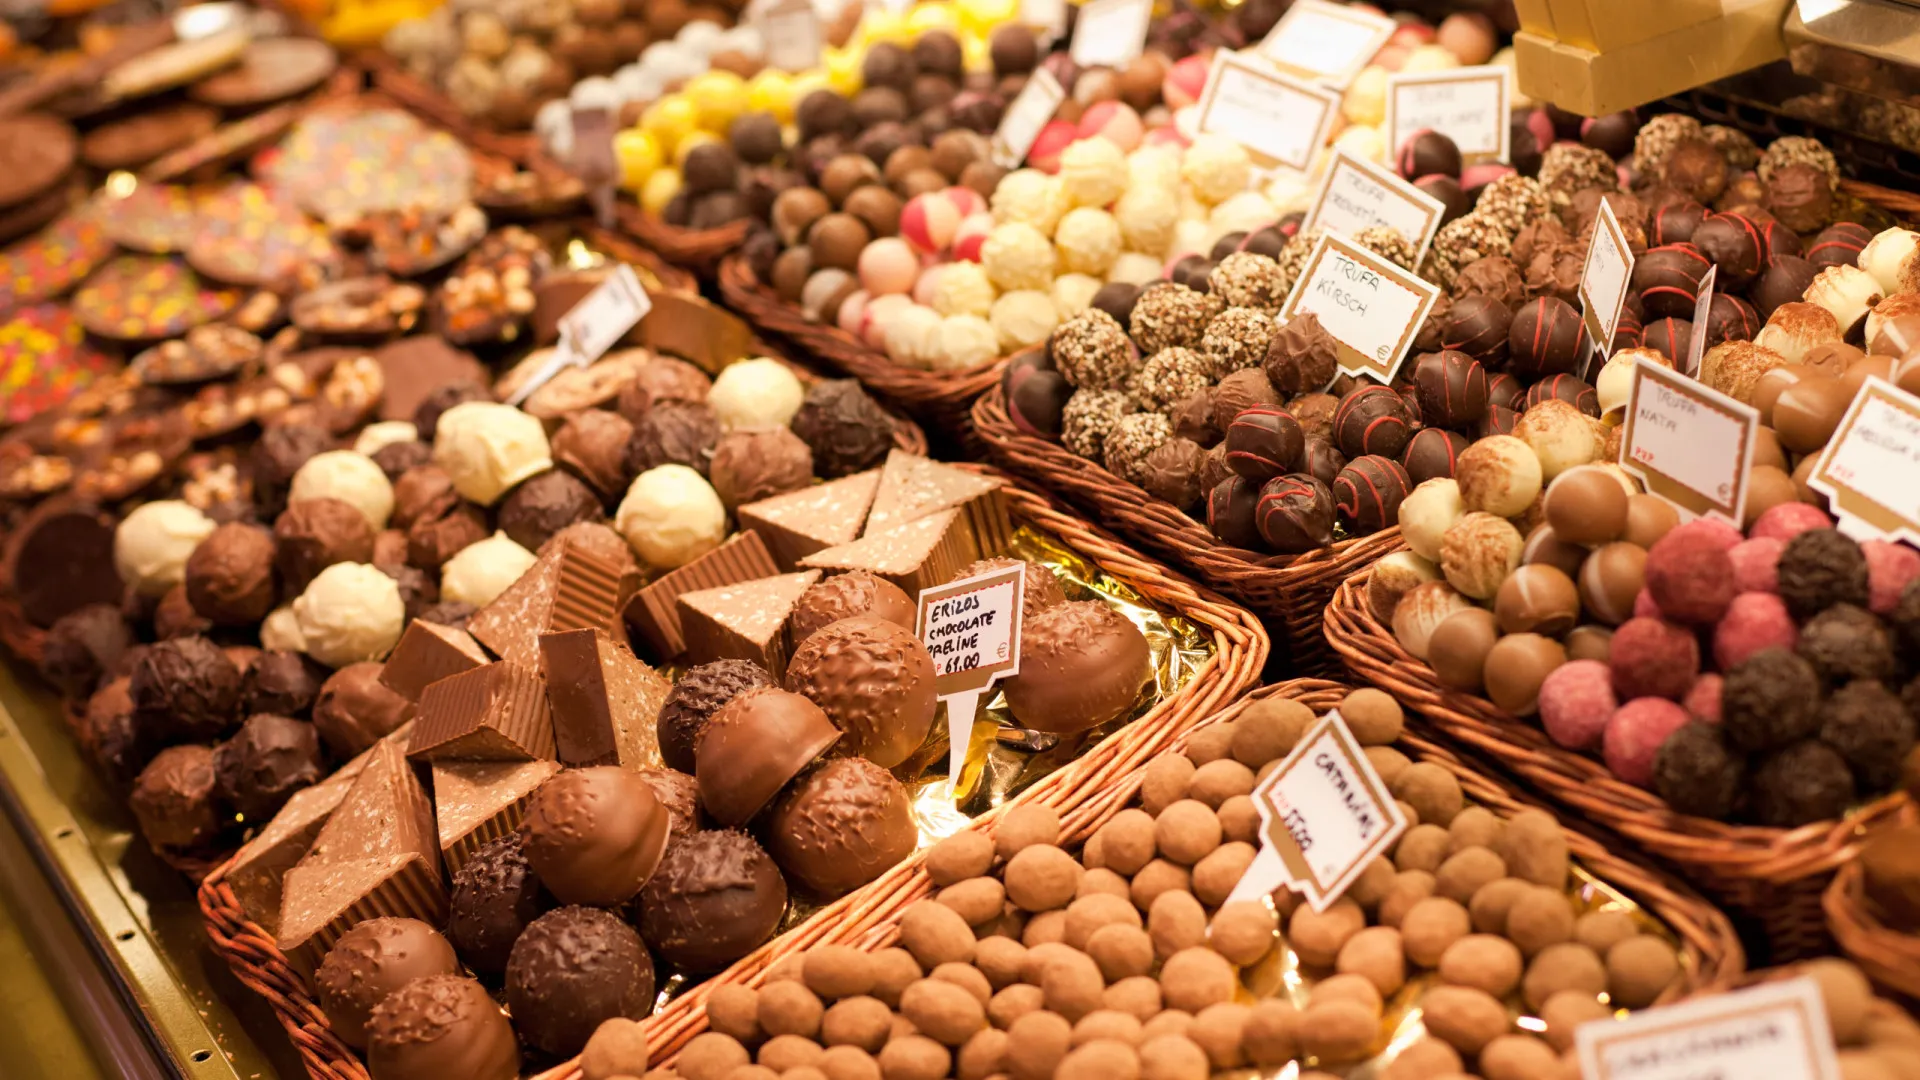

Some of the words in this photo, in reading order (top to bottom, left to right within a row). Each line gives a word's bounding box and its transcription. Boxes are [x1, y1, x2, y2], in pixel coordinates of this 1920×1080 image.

[1333, 256, 1380, 292] TRUFA
[1639, 407, 1677, 433] NATA
[929, 610, 996, 640] CHOCOLATE
